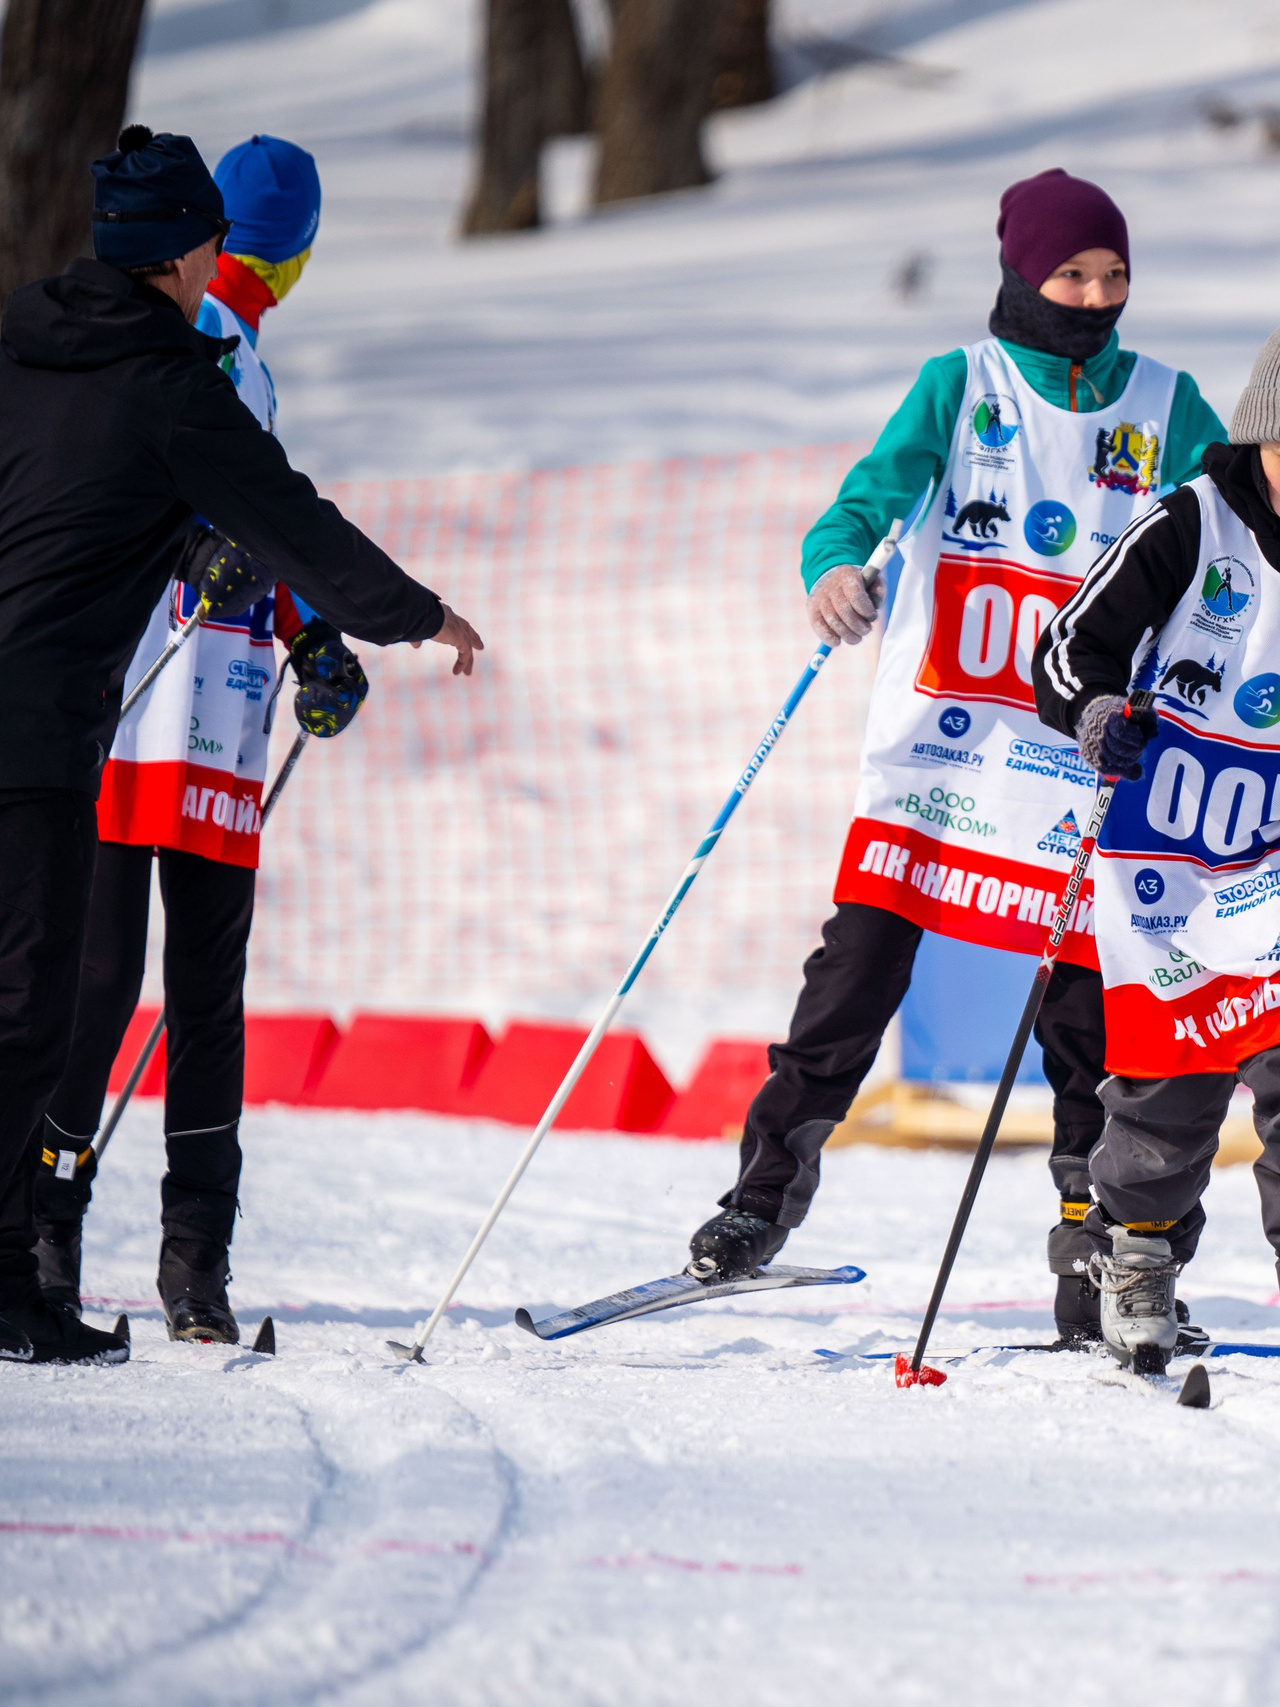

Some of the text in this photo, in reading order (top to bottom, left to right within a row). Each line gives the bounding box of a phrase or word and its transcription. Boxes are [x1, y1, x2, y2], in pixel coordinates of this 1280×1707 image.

[1201, 603, 1236, 624] СФЛГХК
[735, 709, 790, 796] NORDWAY
[910, 742, 985, 767] АВТОЗАКАЗ.РУ
[1005, 757, 1060, 779] ЕДИНОЙ
[1061, 770, 1096, 788] РОСС
[929, 787, 975, 812] ООО
[1088, 793, 1110, 837] STC
[858, 840, 911, 883] ЛК
[1037, 841, 1078, 859] СТРО
[1215, 893, 1267, 918] ЕДИНОЙ
